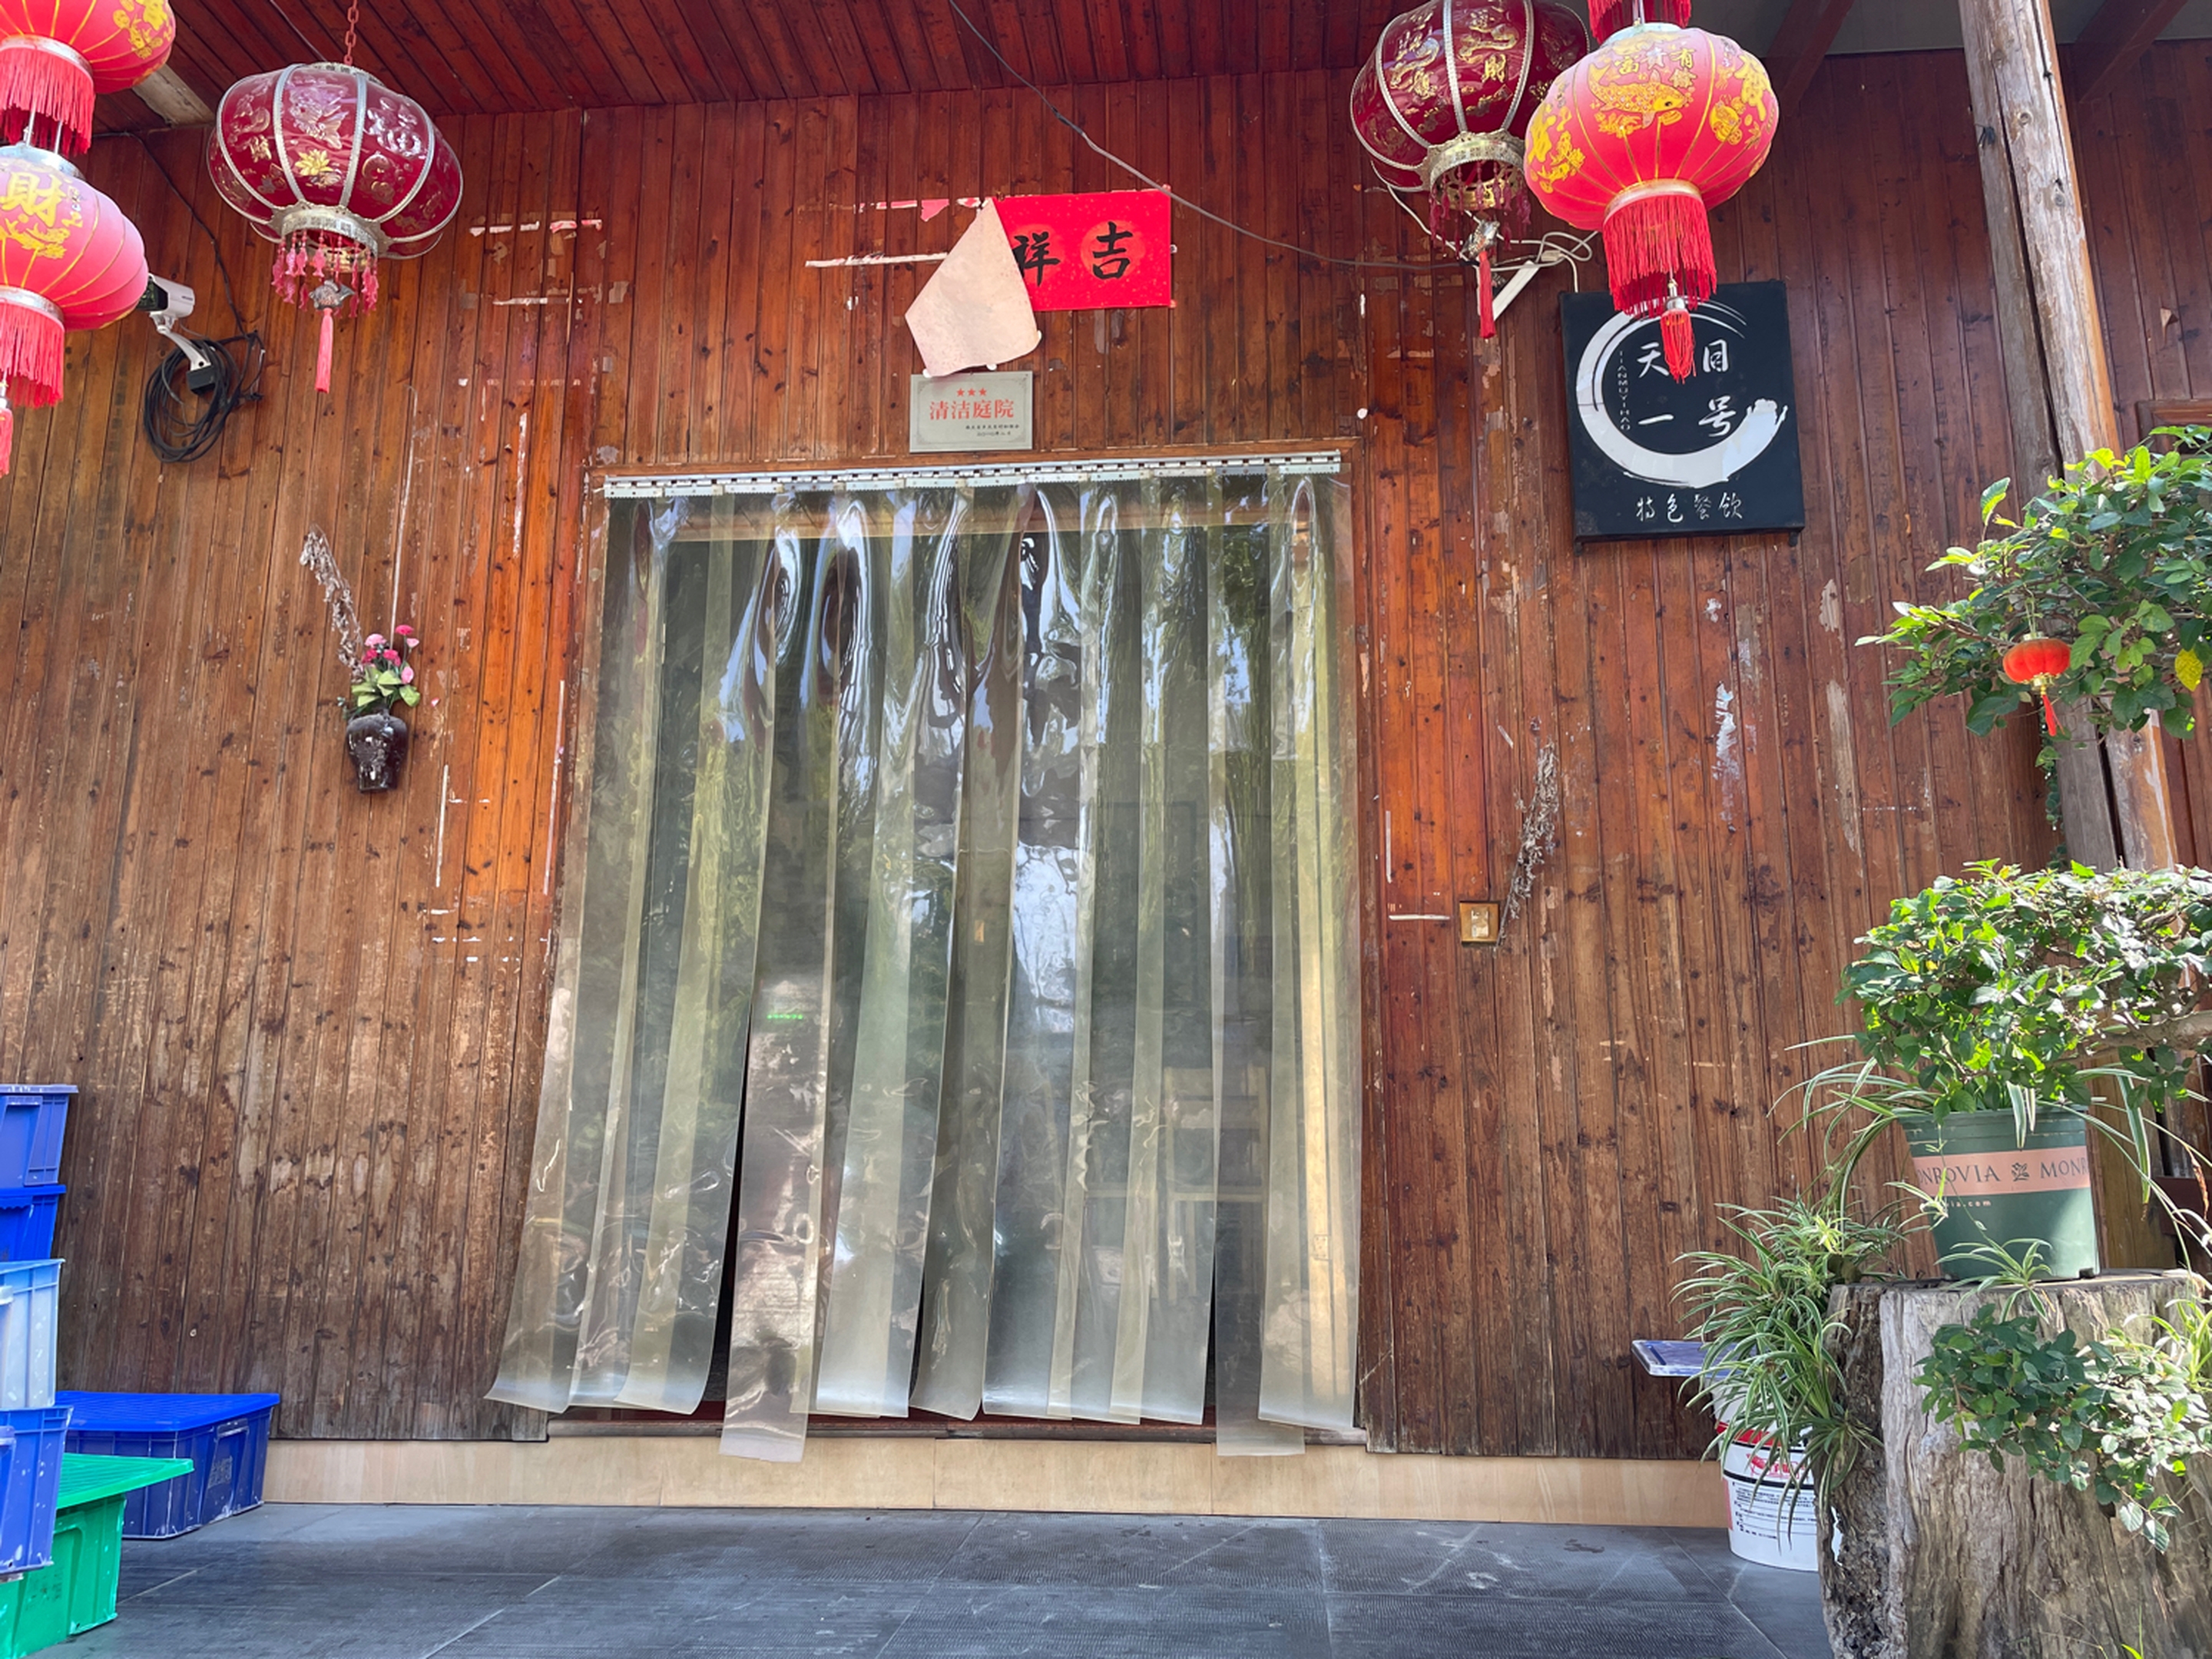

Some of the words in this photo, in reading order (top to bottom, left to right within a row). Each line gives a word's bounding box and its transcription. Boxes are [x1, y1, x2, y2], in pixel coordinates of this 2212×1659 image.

[0, 171, 66, 228] 財
[929, 399, 1015, 420] 清洁庭院
[1638, 396, 1736, 437] 一号
[1635, 492, 1743, 523] 特色餐饮
